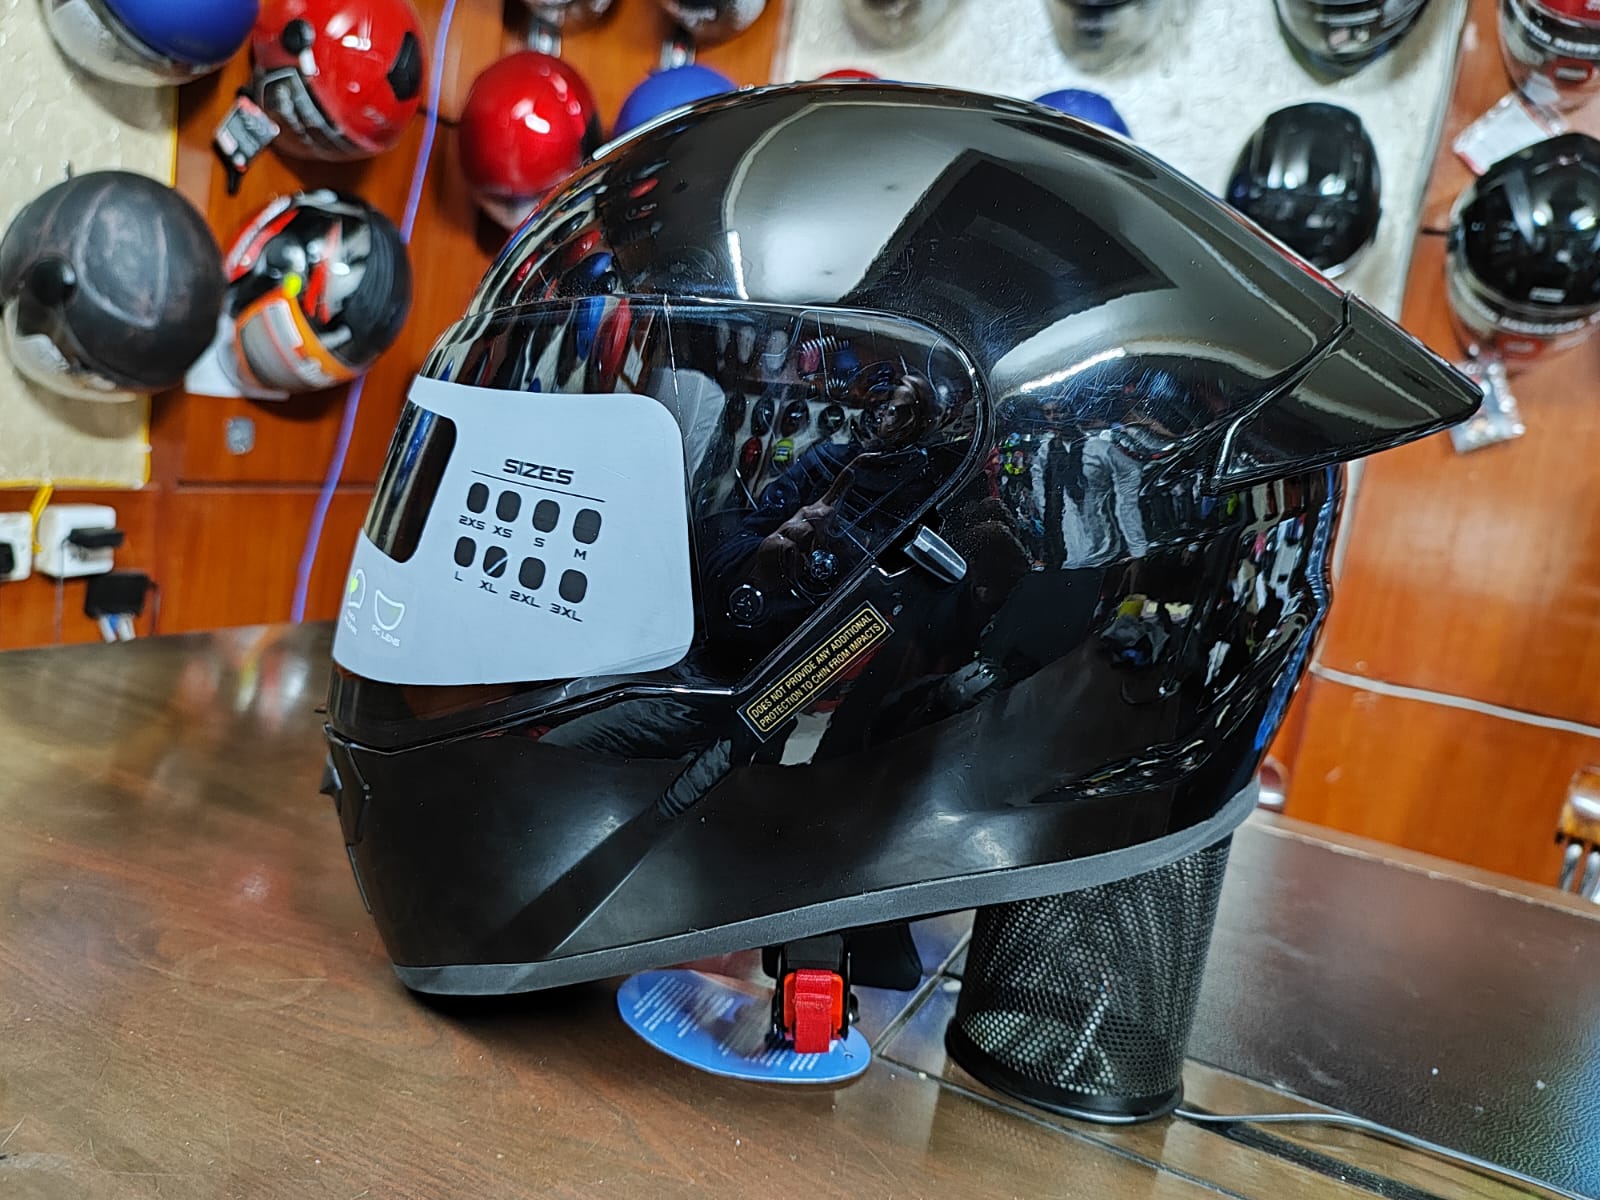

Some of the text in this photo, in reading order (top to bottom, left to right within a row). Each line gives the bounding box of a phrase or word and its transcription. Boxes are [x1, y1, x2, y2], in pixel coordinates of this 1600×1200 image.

[502, 459, 574, 485] SIZES
[458, 515, 587, 560] 2XS XS S M
[454, 571, 583, 622] L XL 2XL 3XL
[752, 614, 873, 718] DOES NOT PROVIDE ANY ADDITIONAL
[759, 623, 881, 727] PROTECTION TO CHIN FROM IMPACTS
